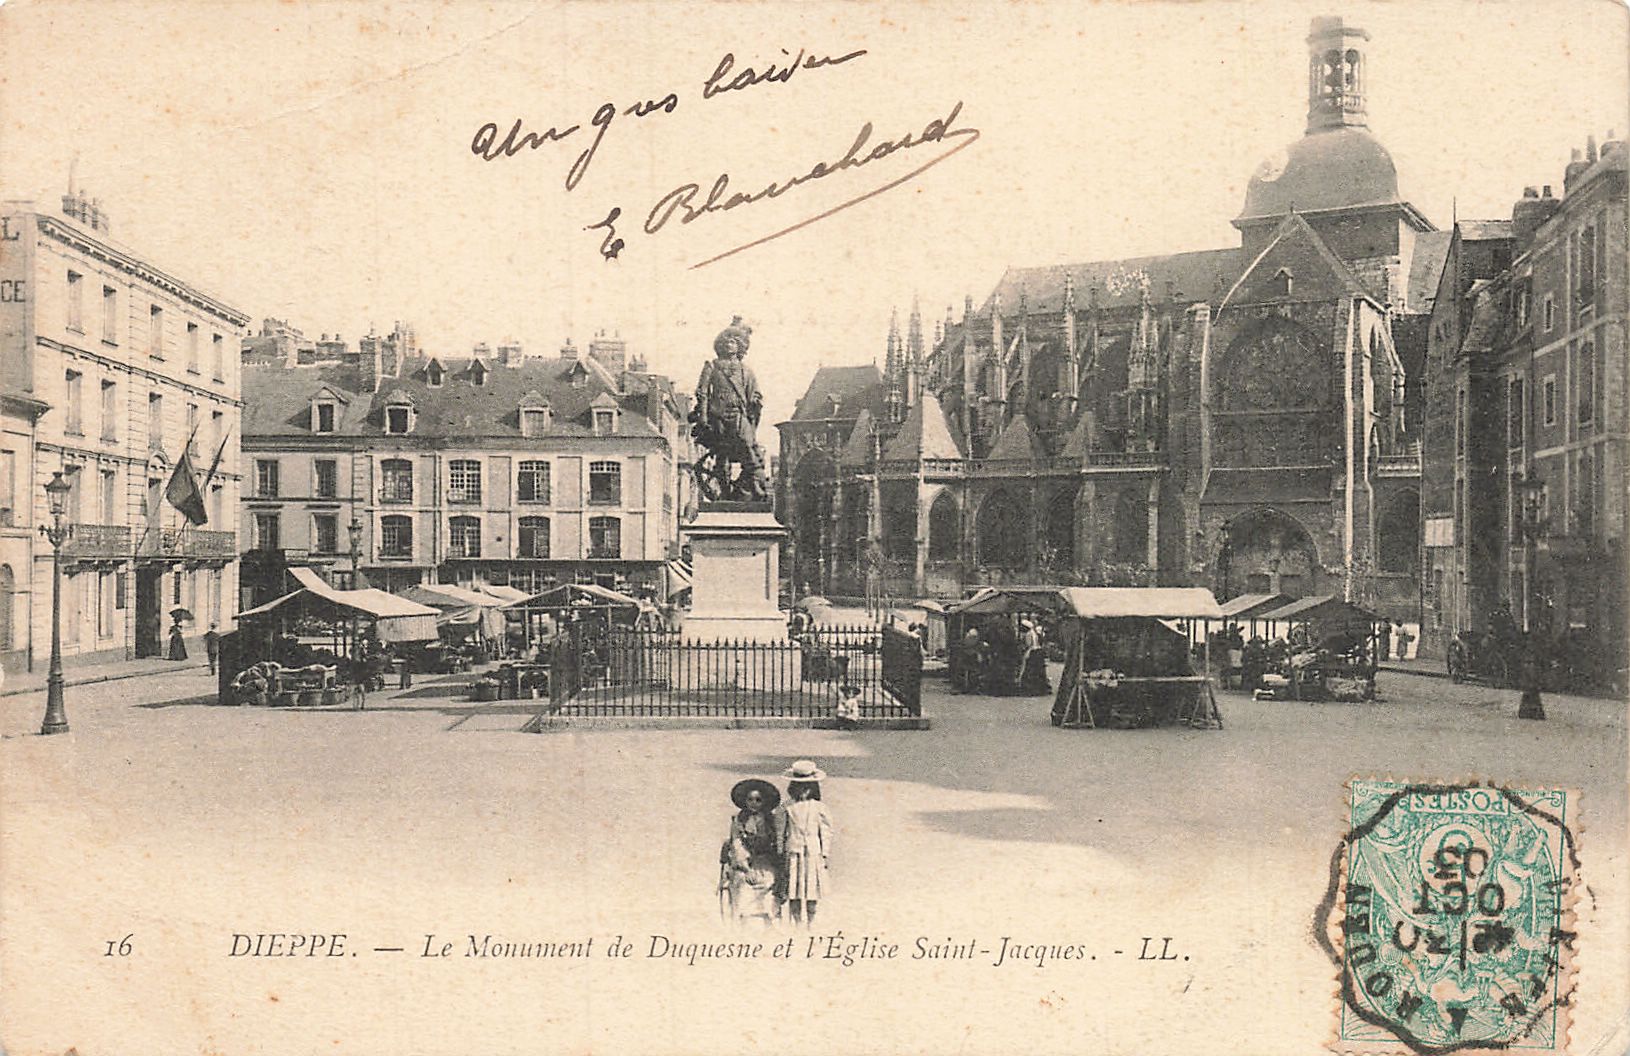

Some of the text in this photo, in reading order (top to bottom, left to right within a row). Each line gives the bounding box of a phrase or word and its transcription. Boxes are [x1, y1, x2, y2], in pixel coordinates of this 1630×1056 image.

[1412, 790, 1507, 811] POSTES
[1412, 880, 1506, 918] OCT
[1342, 883, 1424, 1023] ROUEN
